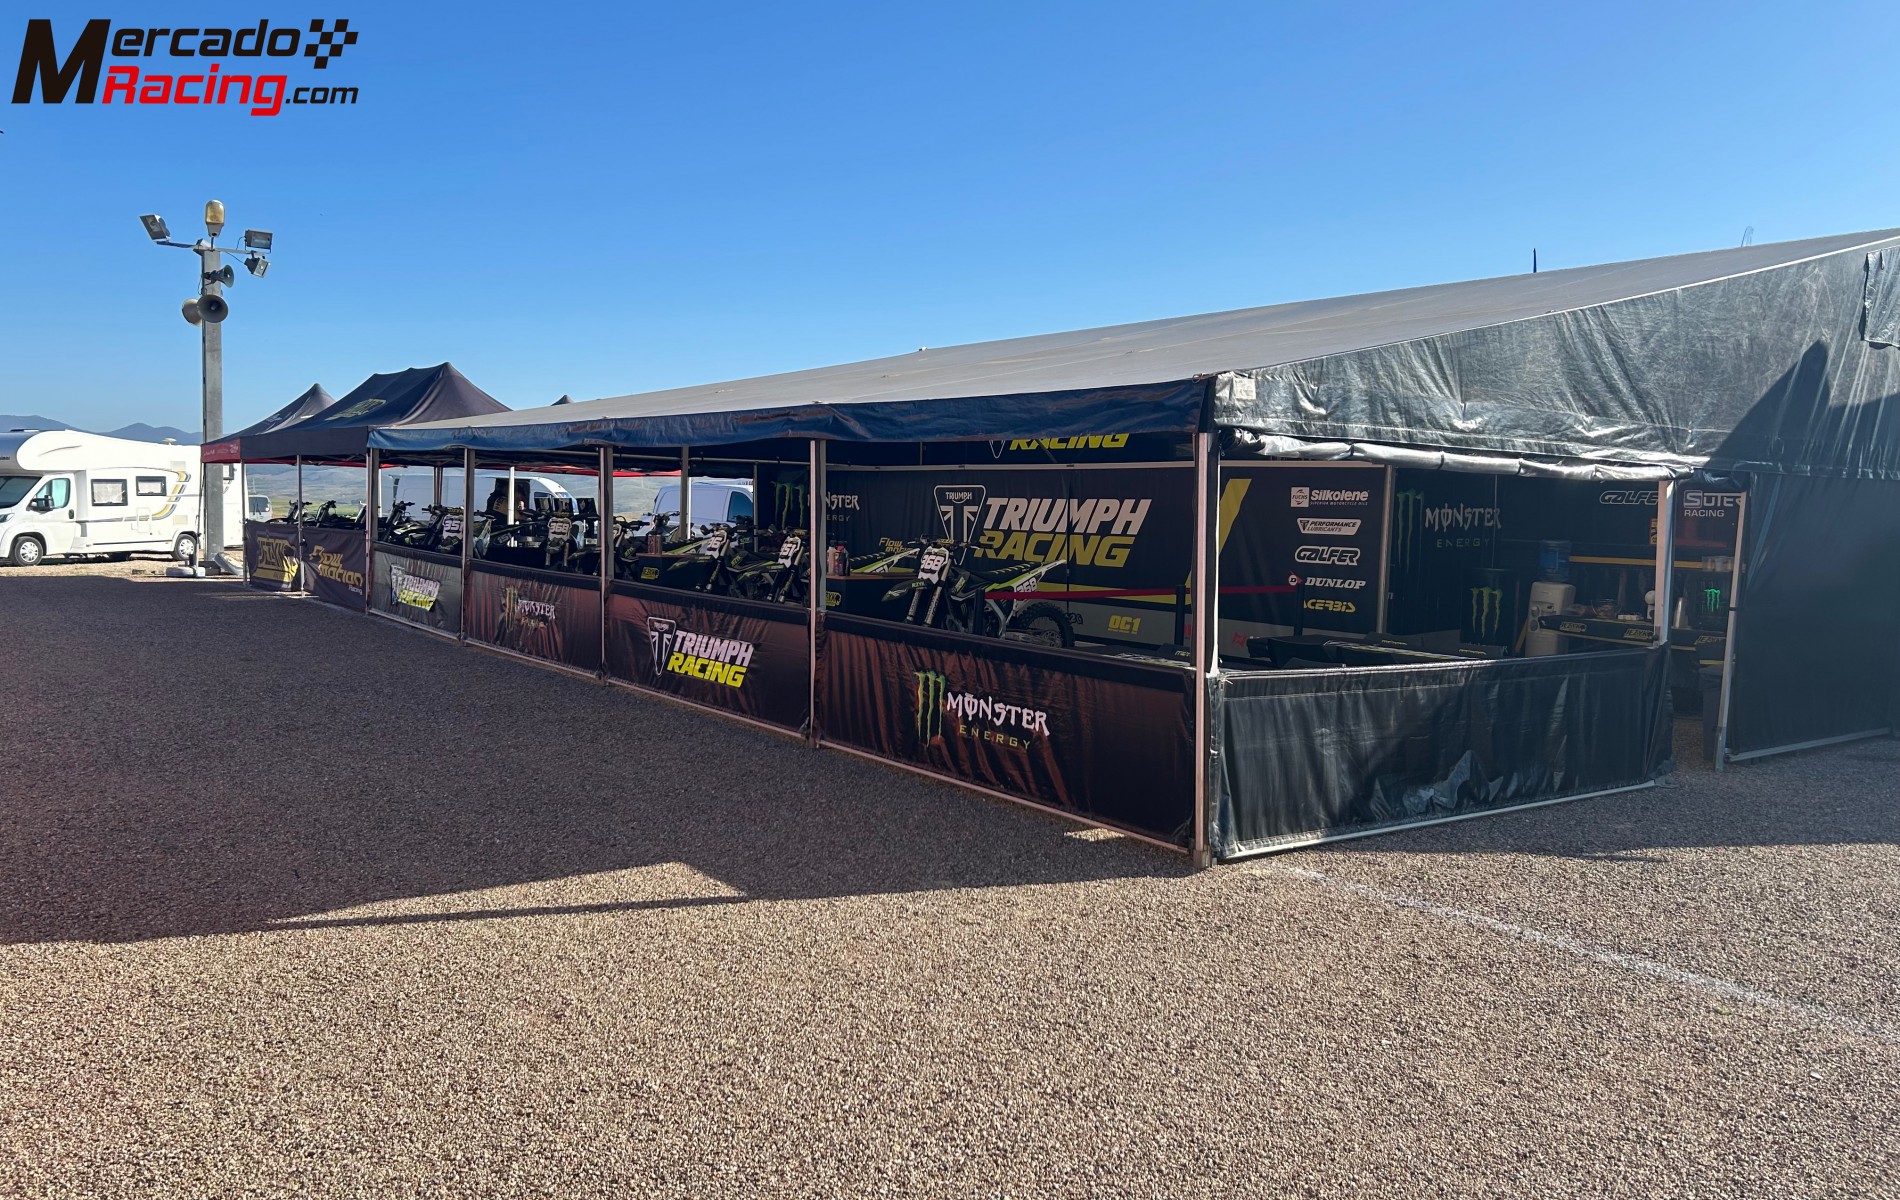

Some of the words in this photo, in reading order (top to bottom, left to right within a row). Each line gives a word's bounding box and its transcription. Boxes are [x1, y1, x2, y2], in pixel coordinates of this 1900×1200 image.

[945, 491, 973, 500] TRIUMPH
[1311, 489, 1369, 501] Silkolene
[1600, 490, 1659, 505] GALFE
[984, 497, 1152, 535] TRIUMPH
[1684, 509, 1725, 518] RACING
[974, 530, 1136, 568] RACING
[1436, 537, 1491, 549] ENERGY
[921, 554, 944, 570] 368
[1295, 545, 1360, 566] GALFER
[318, 563, 363, 587] motion
[1304, 576, 1366, 590] DUNLOP
[673, 629, 754, 667] TRIUMPH
[667, 651, 747, 688] RACING
[960, 724, 1031, 750] ENERGY
